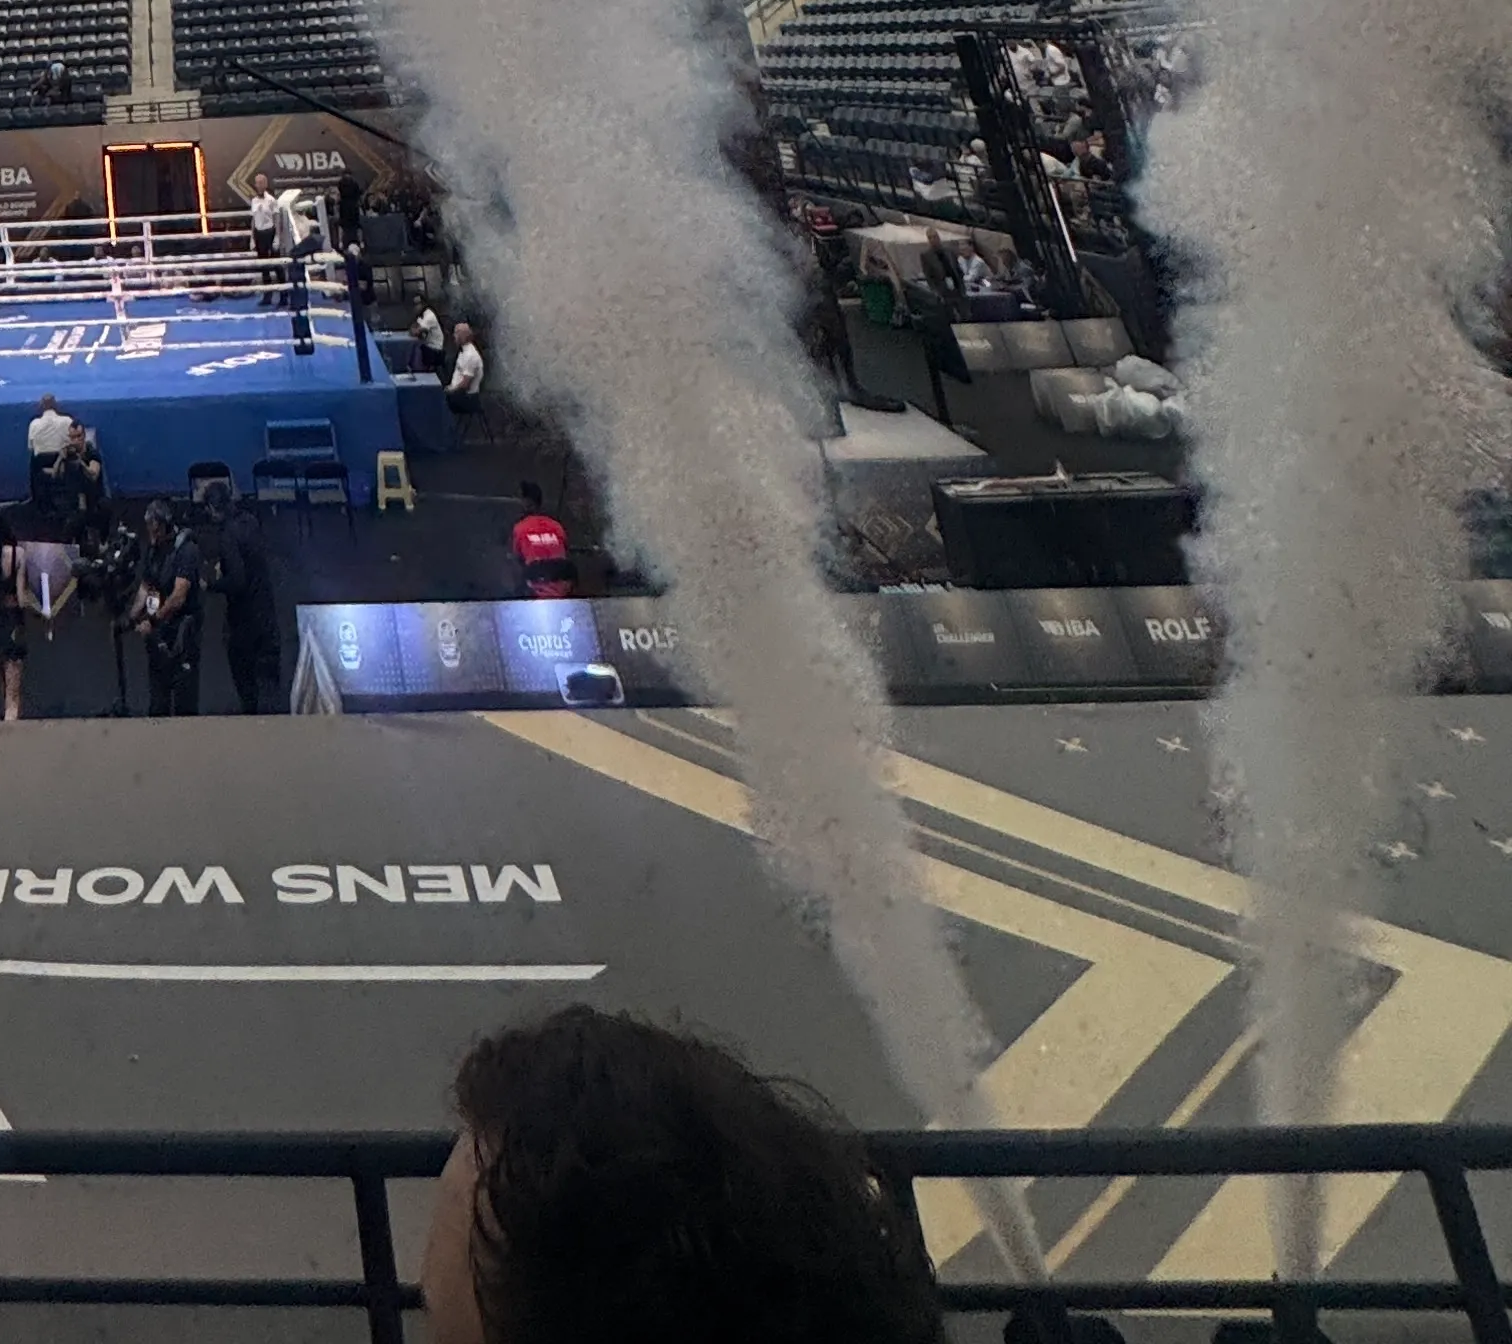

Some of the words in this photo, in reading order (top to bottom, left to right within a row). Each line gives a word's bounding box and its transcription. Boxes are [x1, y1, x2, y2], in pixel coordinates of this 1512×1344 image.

[306, 151, 346, 171] IBA
[618, 626, 680, 650] ROLF
[1144, 616, 1212, 641] ROLF
[271, 864, 563, 904] MENS
